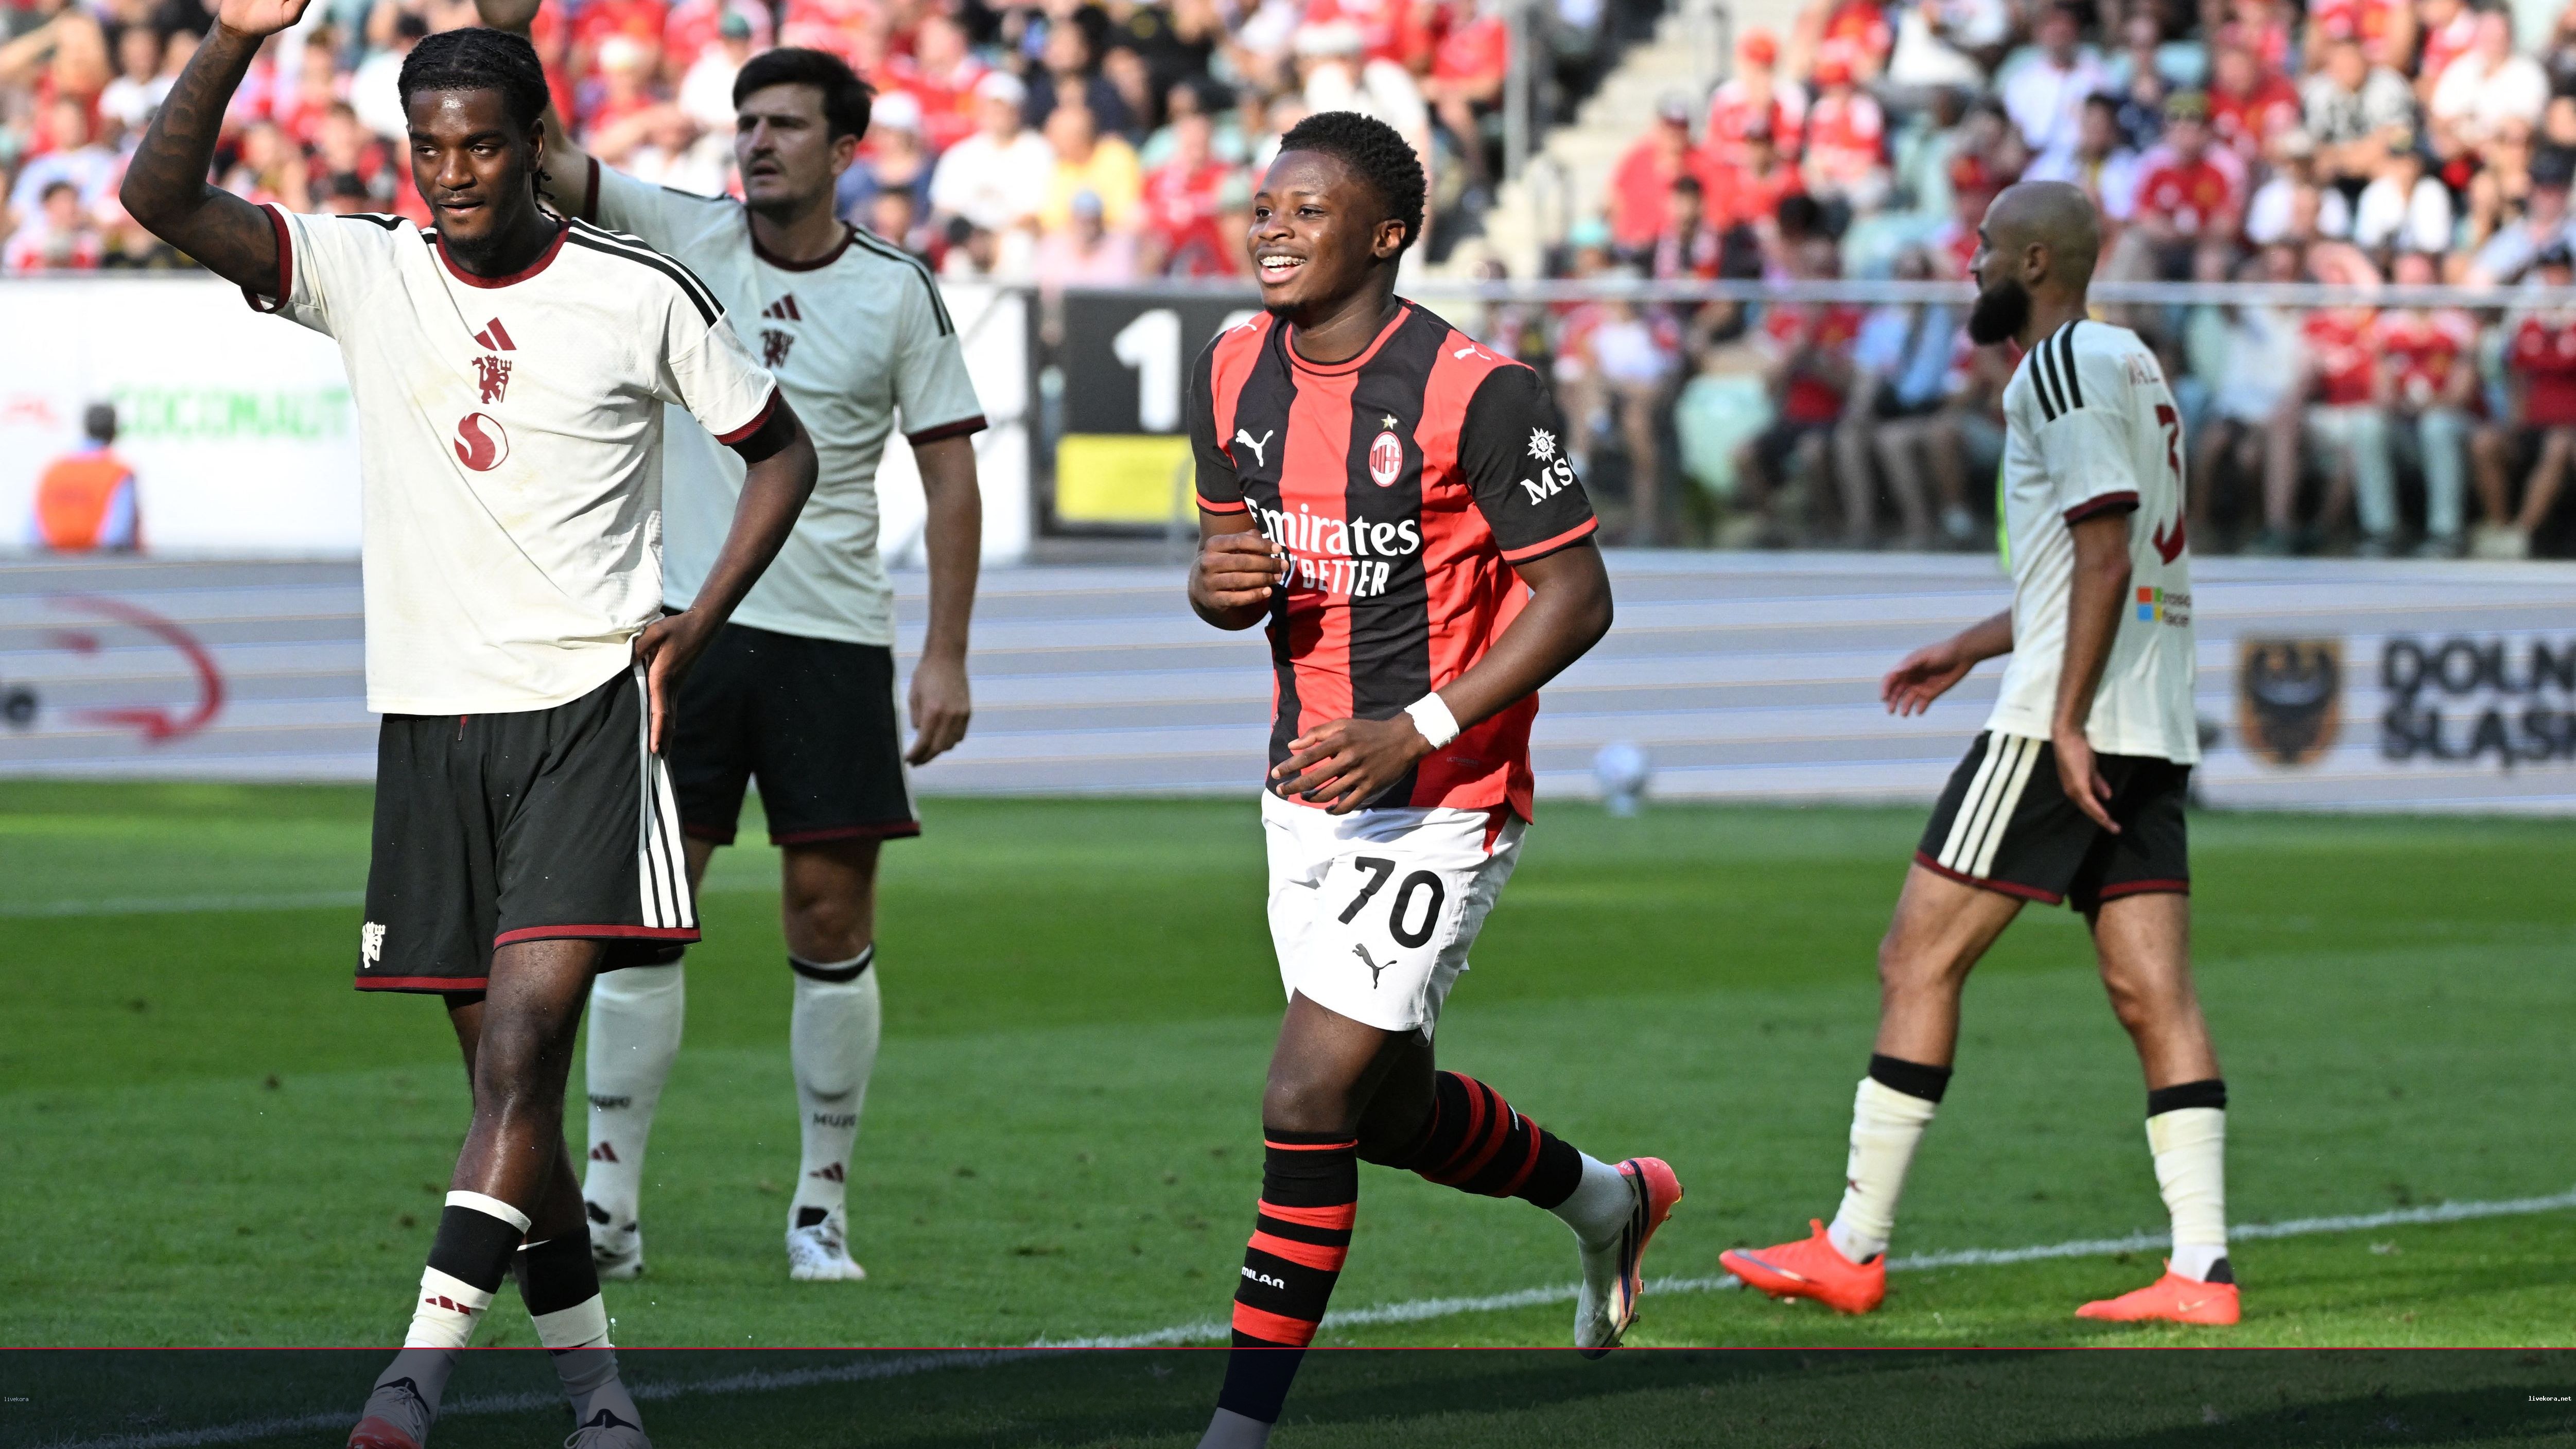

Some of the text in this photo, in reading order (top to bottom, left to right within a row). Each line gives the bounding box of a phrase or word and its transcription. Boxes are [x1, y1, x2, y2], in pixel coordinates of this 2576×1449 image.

[1520, 452, 1577, 505] MS
[1244, 496, 1420, 556] Emirates
[1301, 558, 1390, 597] BETTER
[1338, 856, 1445, 948] 70
